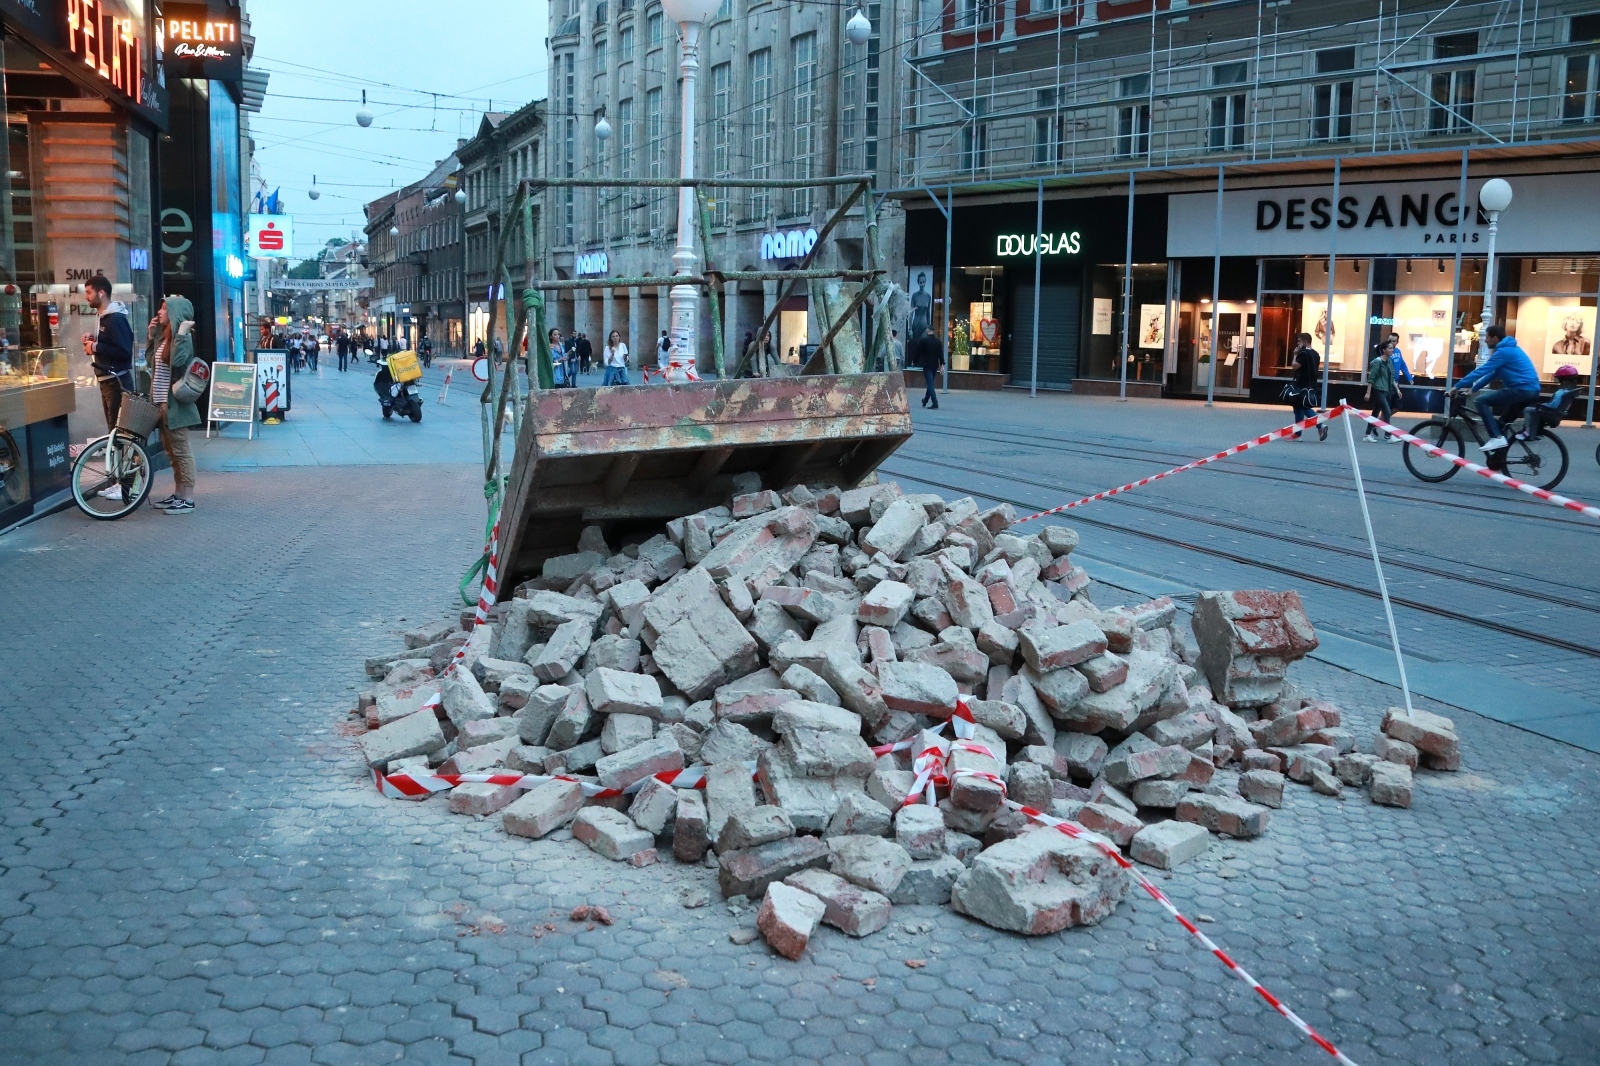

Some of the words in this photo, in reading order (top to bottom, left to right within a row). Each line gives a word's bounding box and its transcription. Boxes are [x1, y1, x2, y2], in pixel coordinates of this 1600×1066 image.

[170, 20, 235, 42] PELATI
[67, 0, 141, 105] PELATI
[761, 228, 819, 260] nama
[997, 231, 1081, 256] DOUGLAS
[1424, 233, 1480, 244] PARIS
[576, 252, 608, 275] nama
[70, 304, 98, 316] PIZZ
[398, 362, 416, 374] Glovo
